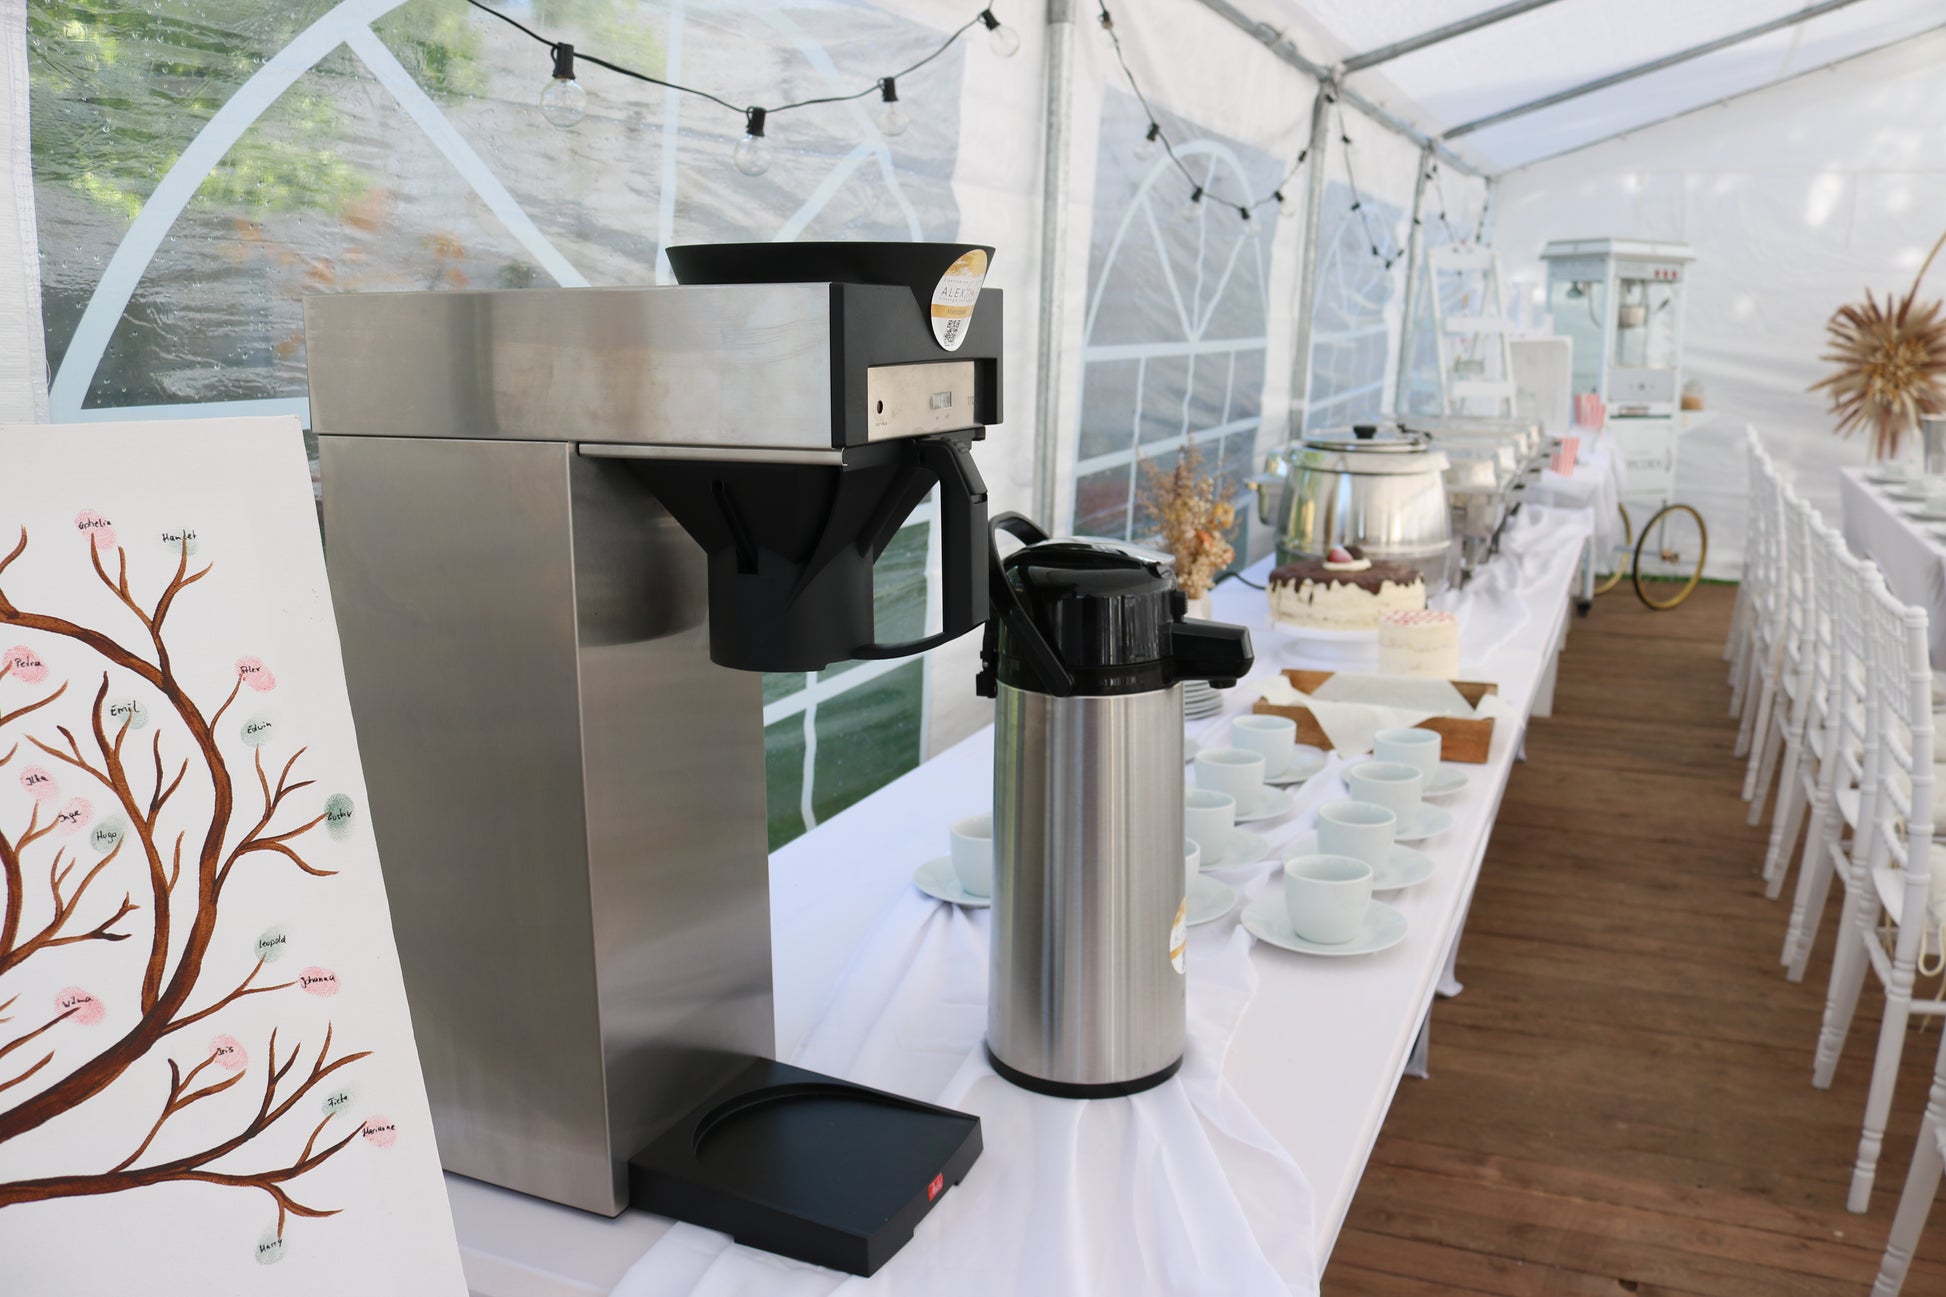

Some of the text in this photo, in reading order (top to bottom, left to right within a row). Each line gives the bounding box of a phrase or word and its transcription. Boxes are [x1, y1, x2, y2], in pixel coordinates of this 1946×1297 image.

[161, 529, 197, 543] Hamlet
[14, 656, 42, 668] Petra
[110, 700, 140, 717] Emil
[247, 721, 272, 734] Edwin
[96, 831, 118, 843] Hugo
[300, 975, 336, 989] Johanna
[362, 1124, 396, 1138] Marianne
[259, 1239, 283, 1253] Harry
